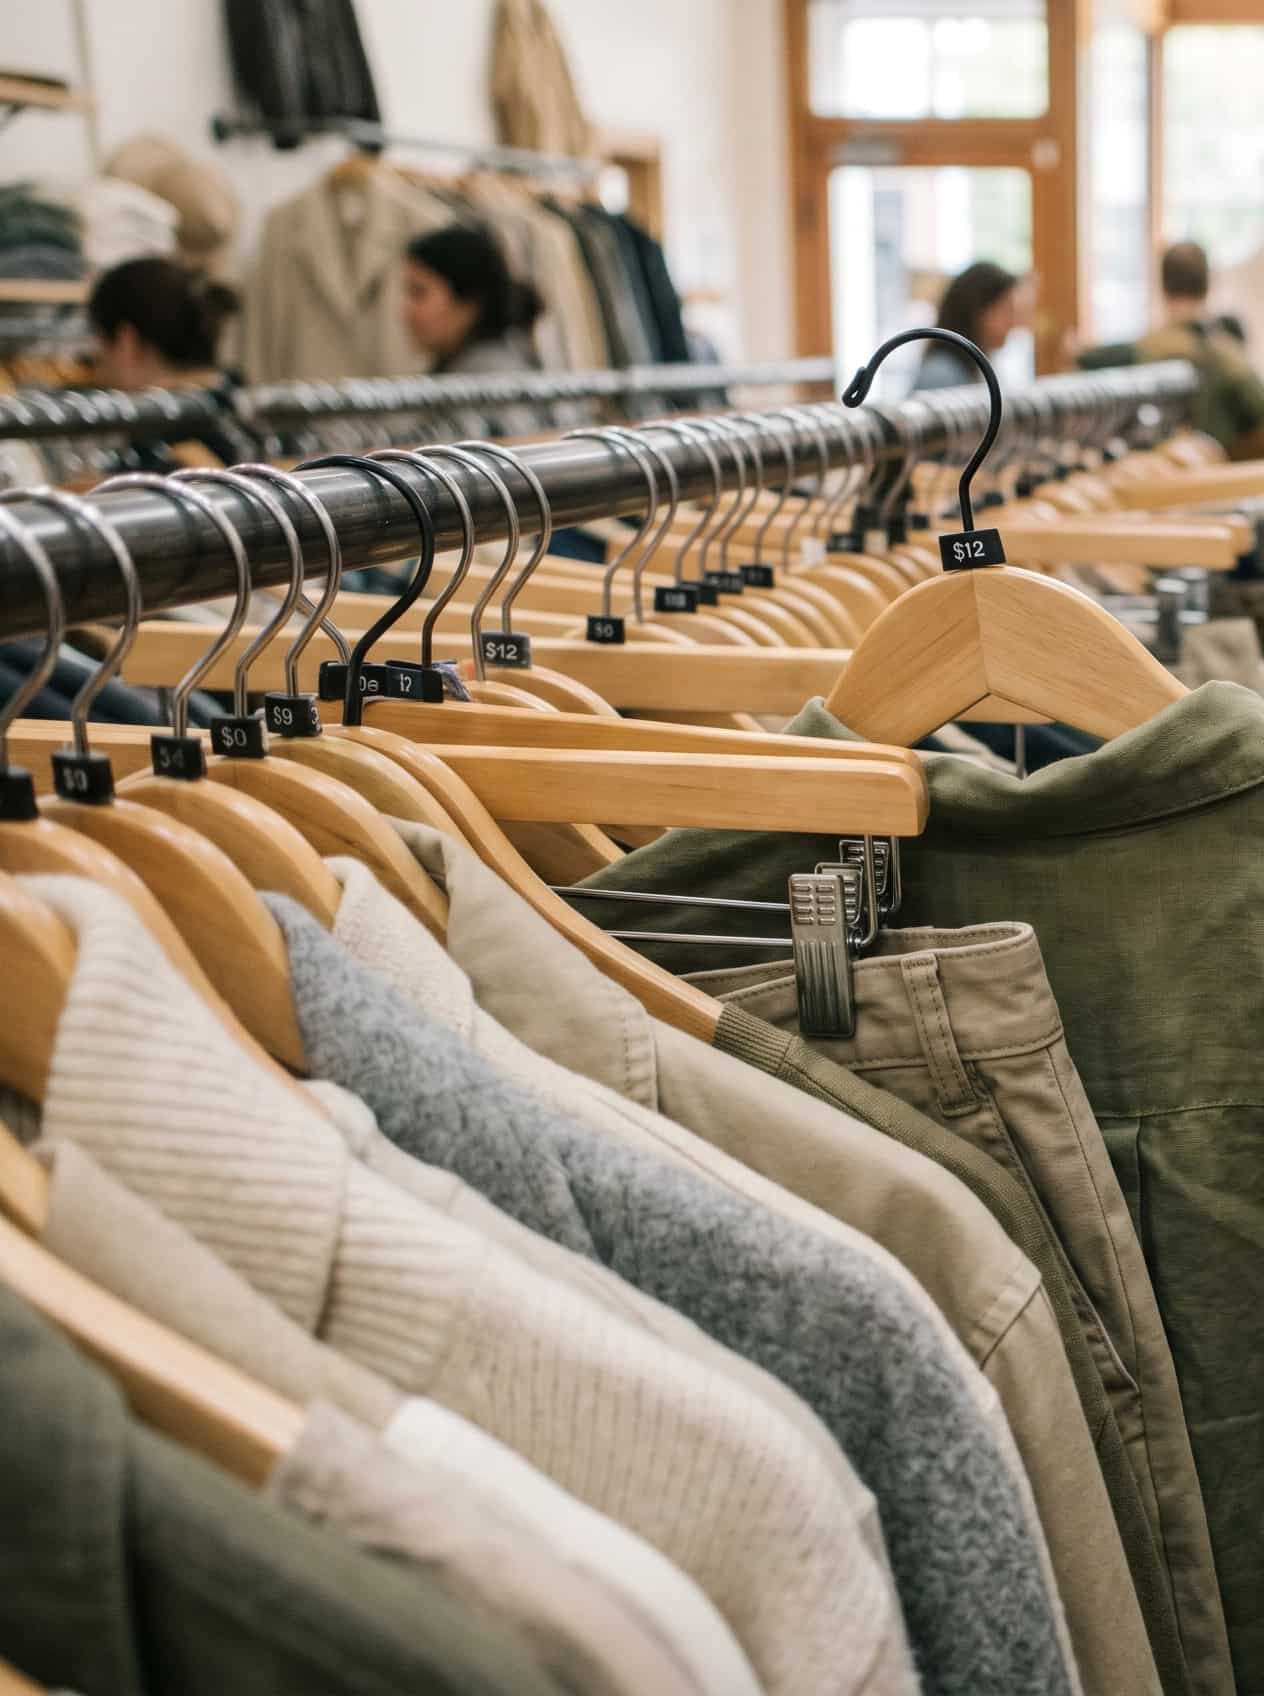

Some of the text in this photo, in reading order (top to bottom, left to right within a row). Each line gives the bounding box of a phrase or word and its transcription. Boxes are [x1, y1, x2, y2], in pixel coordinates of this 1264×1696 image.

[952, 540, 985, 563] $12
[485, 641, 518, 660] $12
[221, 726, 248, 748] $0
